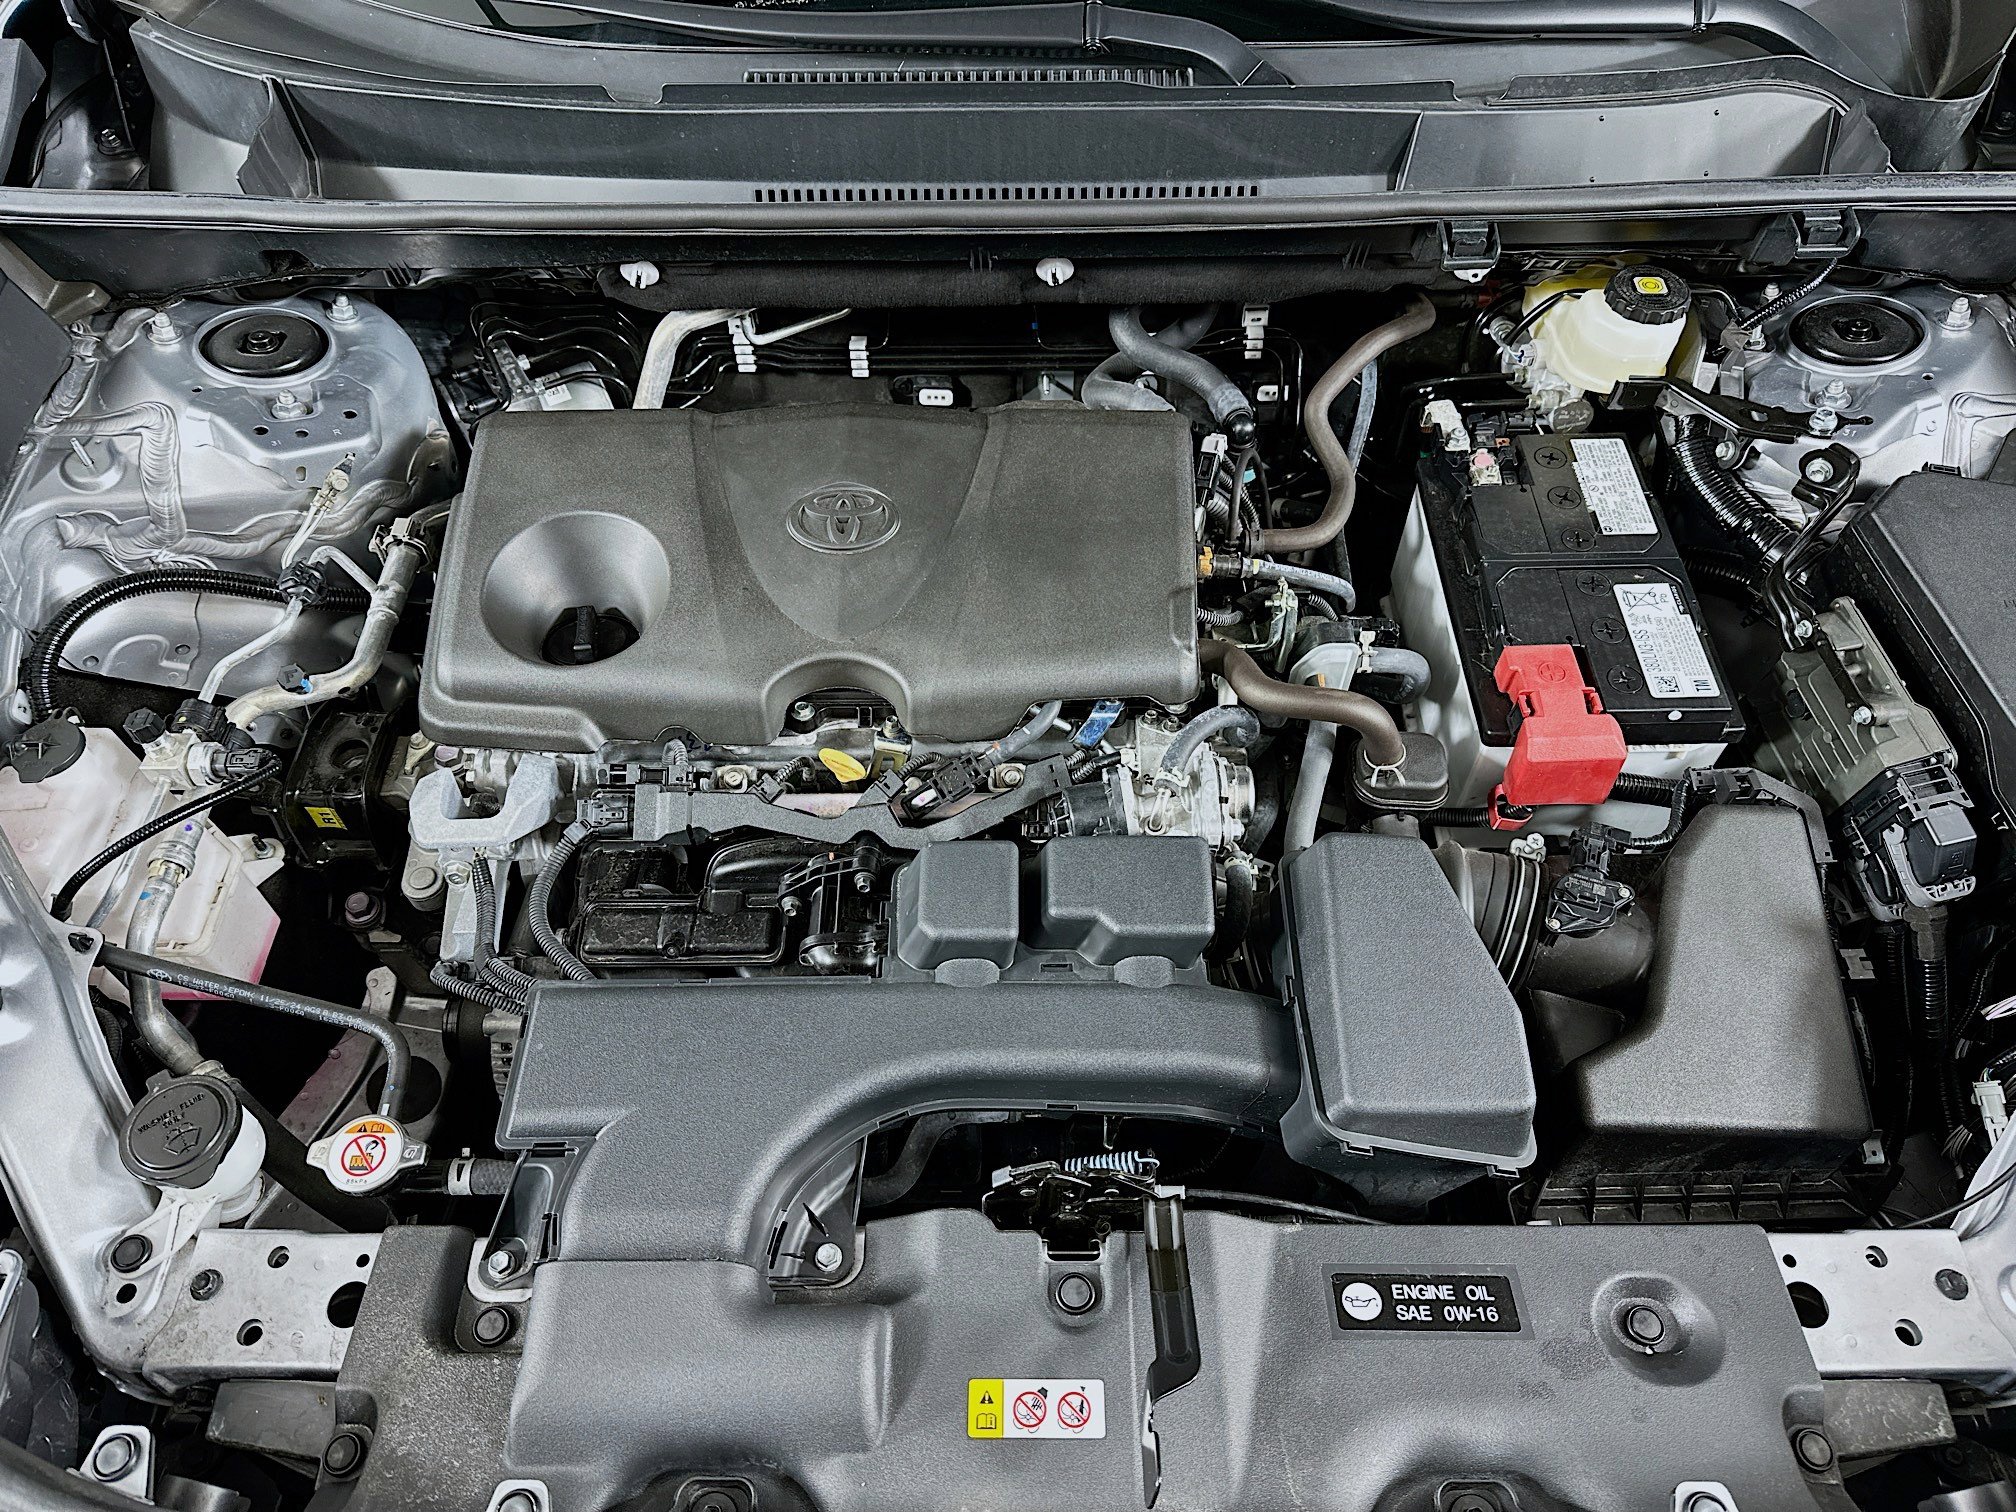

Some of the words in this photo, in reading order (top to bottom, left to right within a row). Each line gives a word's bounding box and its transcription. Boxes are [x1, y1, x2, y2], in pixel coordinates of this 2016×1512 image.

[177, 973, 189, 982] CS
[193, 977, 220, 990] WATER
[1391, 1284, 1456, 1300] ENGINE
[1465, 1285, 1496, 1301] OIL
[1396, 1305, 1433, 1321] SAE
[1443, 1305, 1499, 1322] 0W-16
